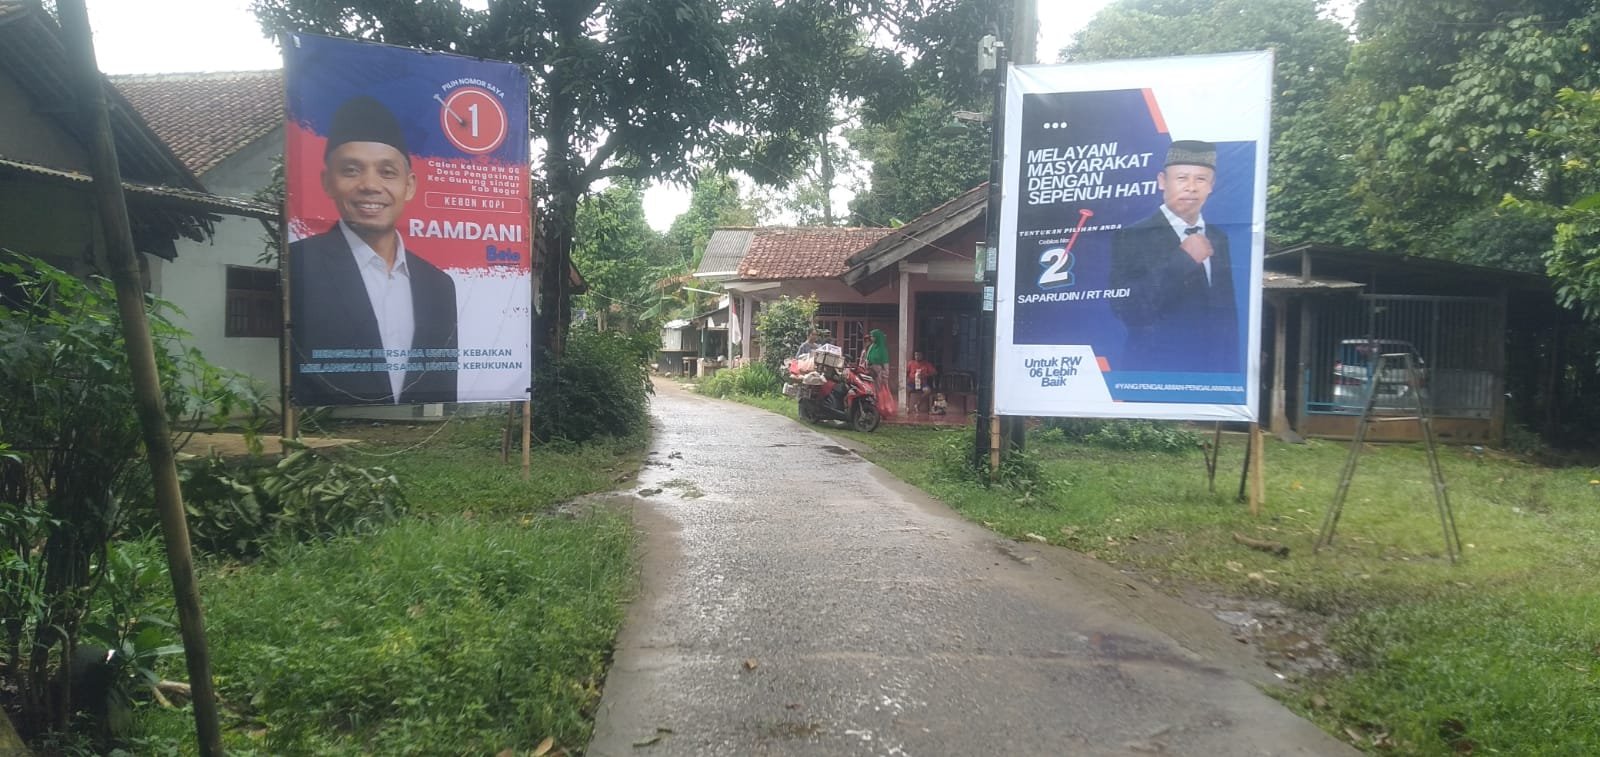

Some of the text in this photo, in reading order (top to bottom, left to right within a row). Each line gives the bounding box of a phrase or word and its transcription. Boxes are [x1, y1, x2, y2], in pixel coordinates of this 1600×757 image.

[442, 78, 505, 98] PILIH NOMOR SAYA
[468, 103, 478, 137] 1
[1027, 142, 1118, 164] MELAYANI
[428, 160, 457, 169] Calon
[1027, 152, 1153, 178] MASYARAKAT
[427, 174, 446, 182] Kec
[449, 176, 486, 187] Gunung
[436, 168, 520, 181] Desa Pengasinan
[1028, 171, 1104, 192] DENGAN
[471, 185, 520, 196] Kab Bogor
[1028, 181, 1157, 205] SEPENUH HATI
[444, 196, 505, 209] KEBON KOPI
[408, 218, 522, 243] RAMDANI
[1019, 223, 1122, 237] TENTUKAN PILIHAN ANDA
[1038, 248, 1073, 288] 2
[1017, 291, 1080, 304] SAPARUDIN
[1086, 289, 1102, 300] RT
[1103, 288, 1131, 299] RUDI
[463, 348, 512, 358] KEBAIKAN
[463, 361, 522, 370] KERUKUNAN
[1025, 356, 1082, 368] Untuk RW
[1029, 367, 1077, 378] 06 Lebih
[1041, 377, 1067, 387] Baik
